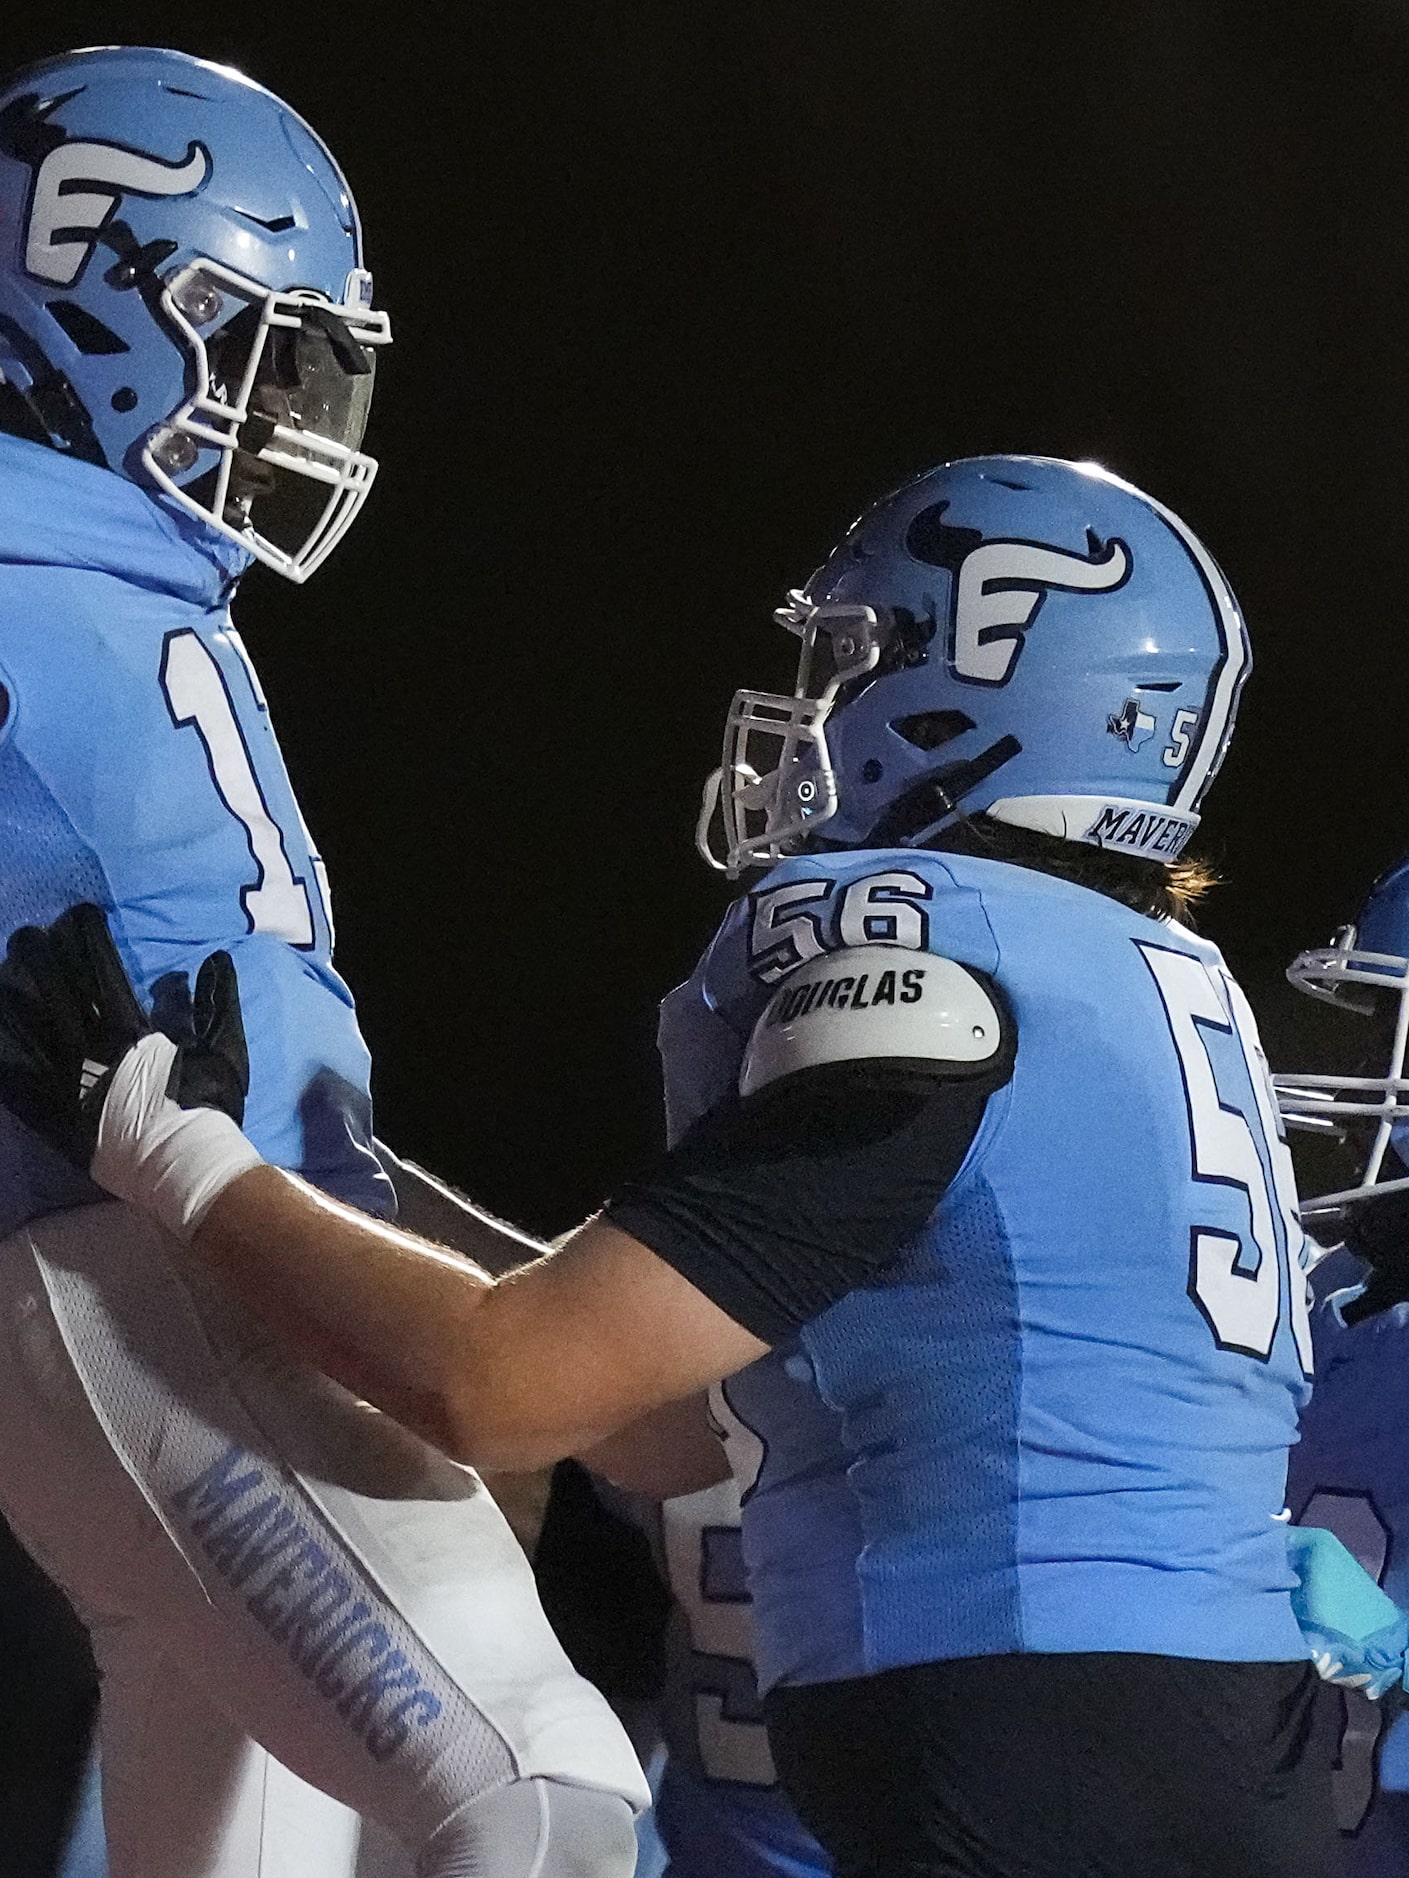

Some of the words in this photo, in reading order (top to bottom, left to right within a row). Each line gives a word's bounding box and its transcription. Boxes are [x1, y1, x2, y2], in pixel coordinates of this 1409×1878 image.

[158, 626, 336, 953] 1
[748, 868, 934, 986] 56
[1129, 937, 1316, 1384] 5
[172, 1446, 442, 1762] MAVERICKS
